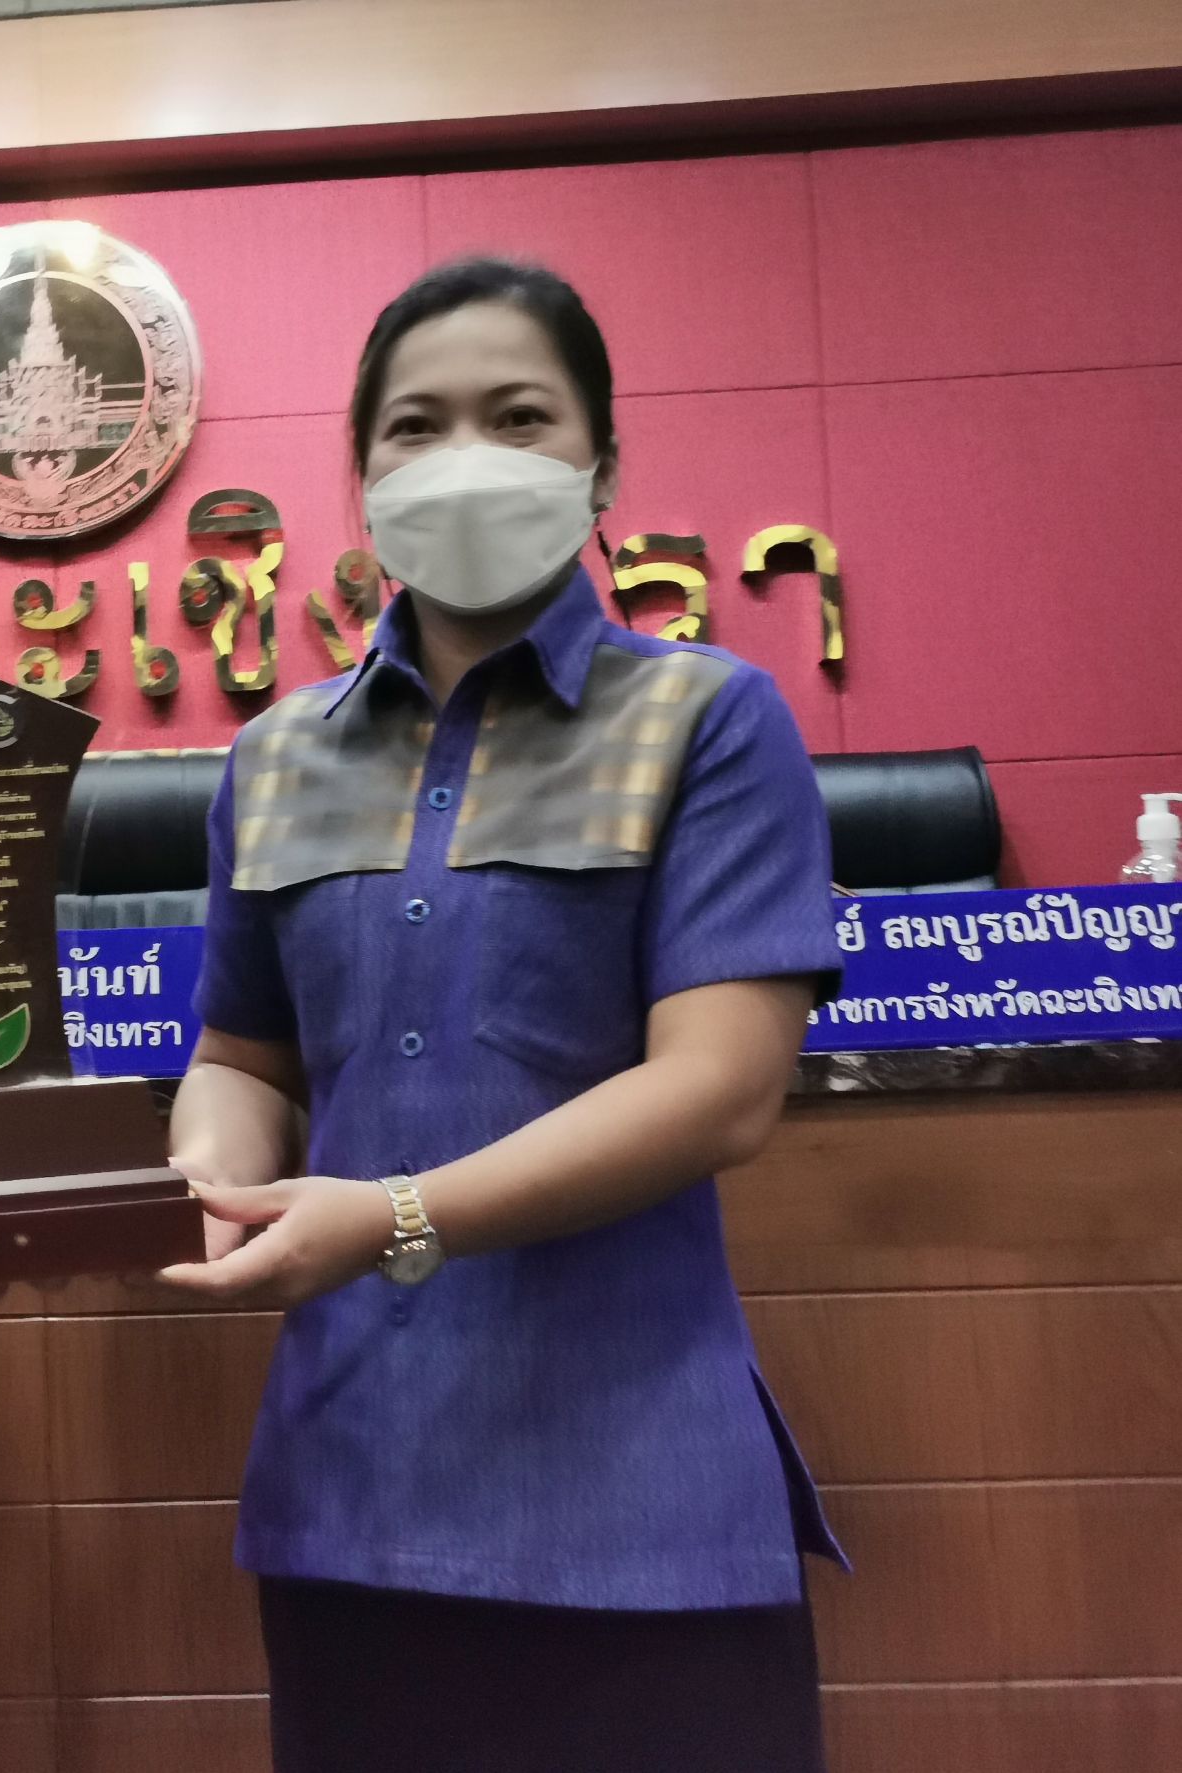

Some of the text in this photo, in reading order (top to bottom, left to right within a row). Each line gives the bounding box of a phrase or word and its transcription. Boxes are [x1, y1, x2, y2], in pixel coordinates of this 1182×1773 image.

[57, 943, 161, 997] นันท์
[807, 976, 1182, 1024] าชการจังหวัดฉะเชิงเท
[63, 1011, 182, 1048] ชิงเทรา
